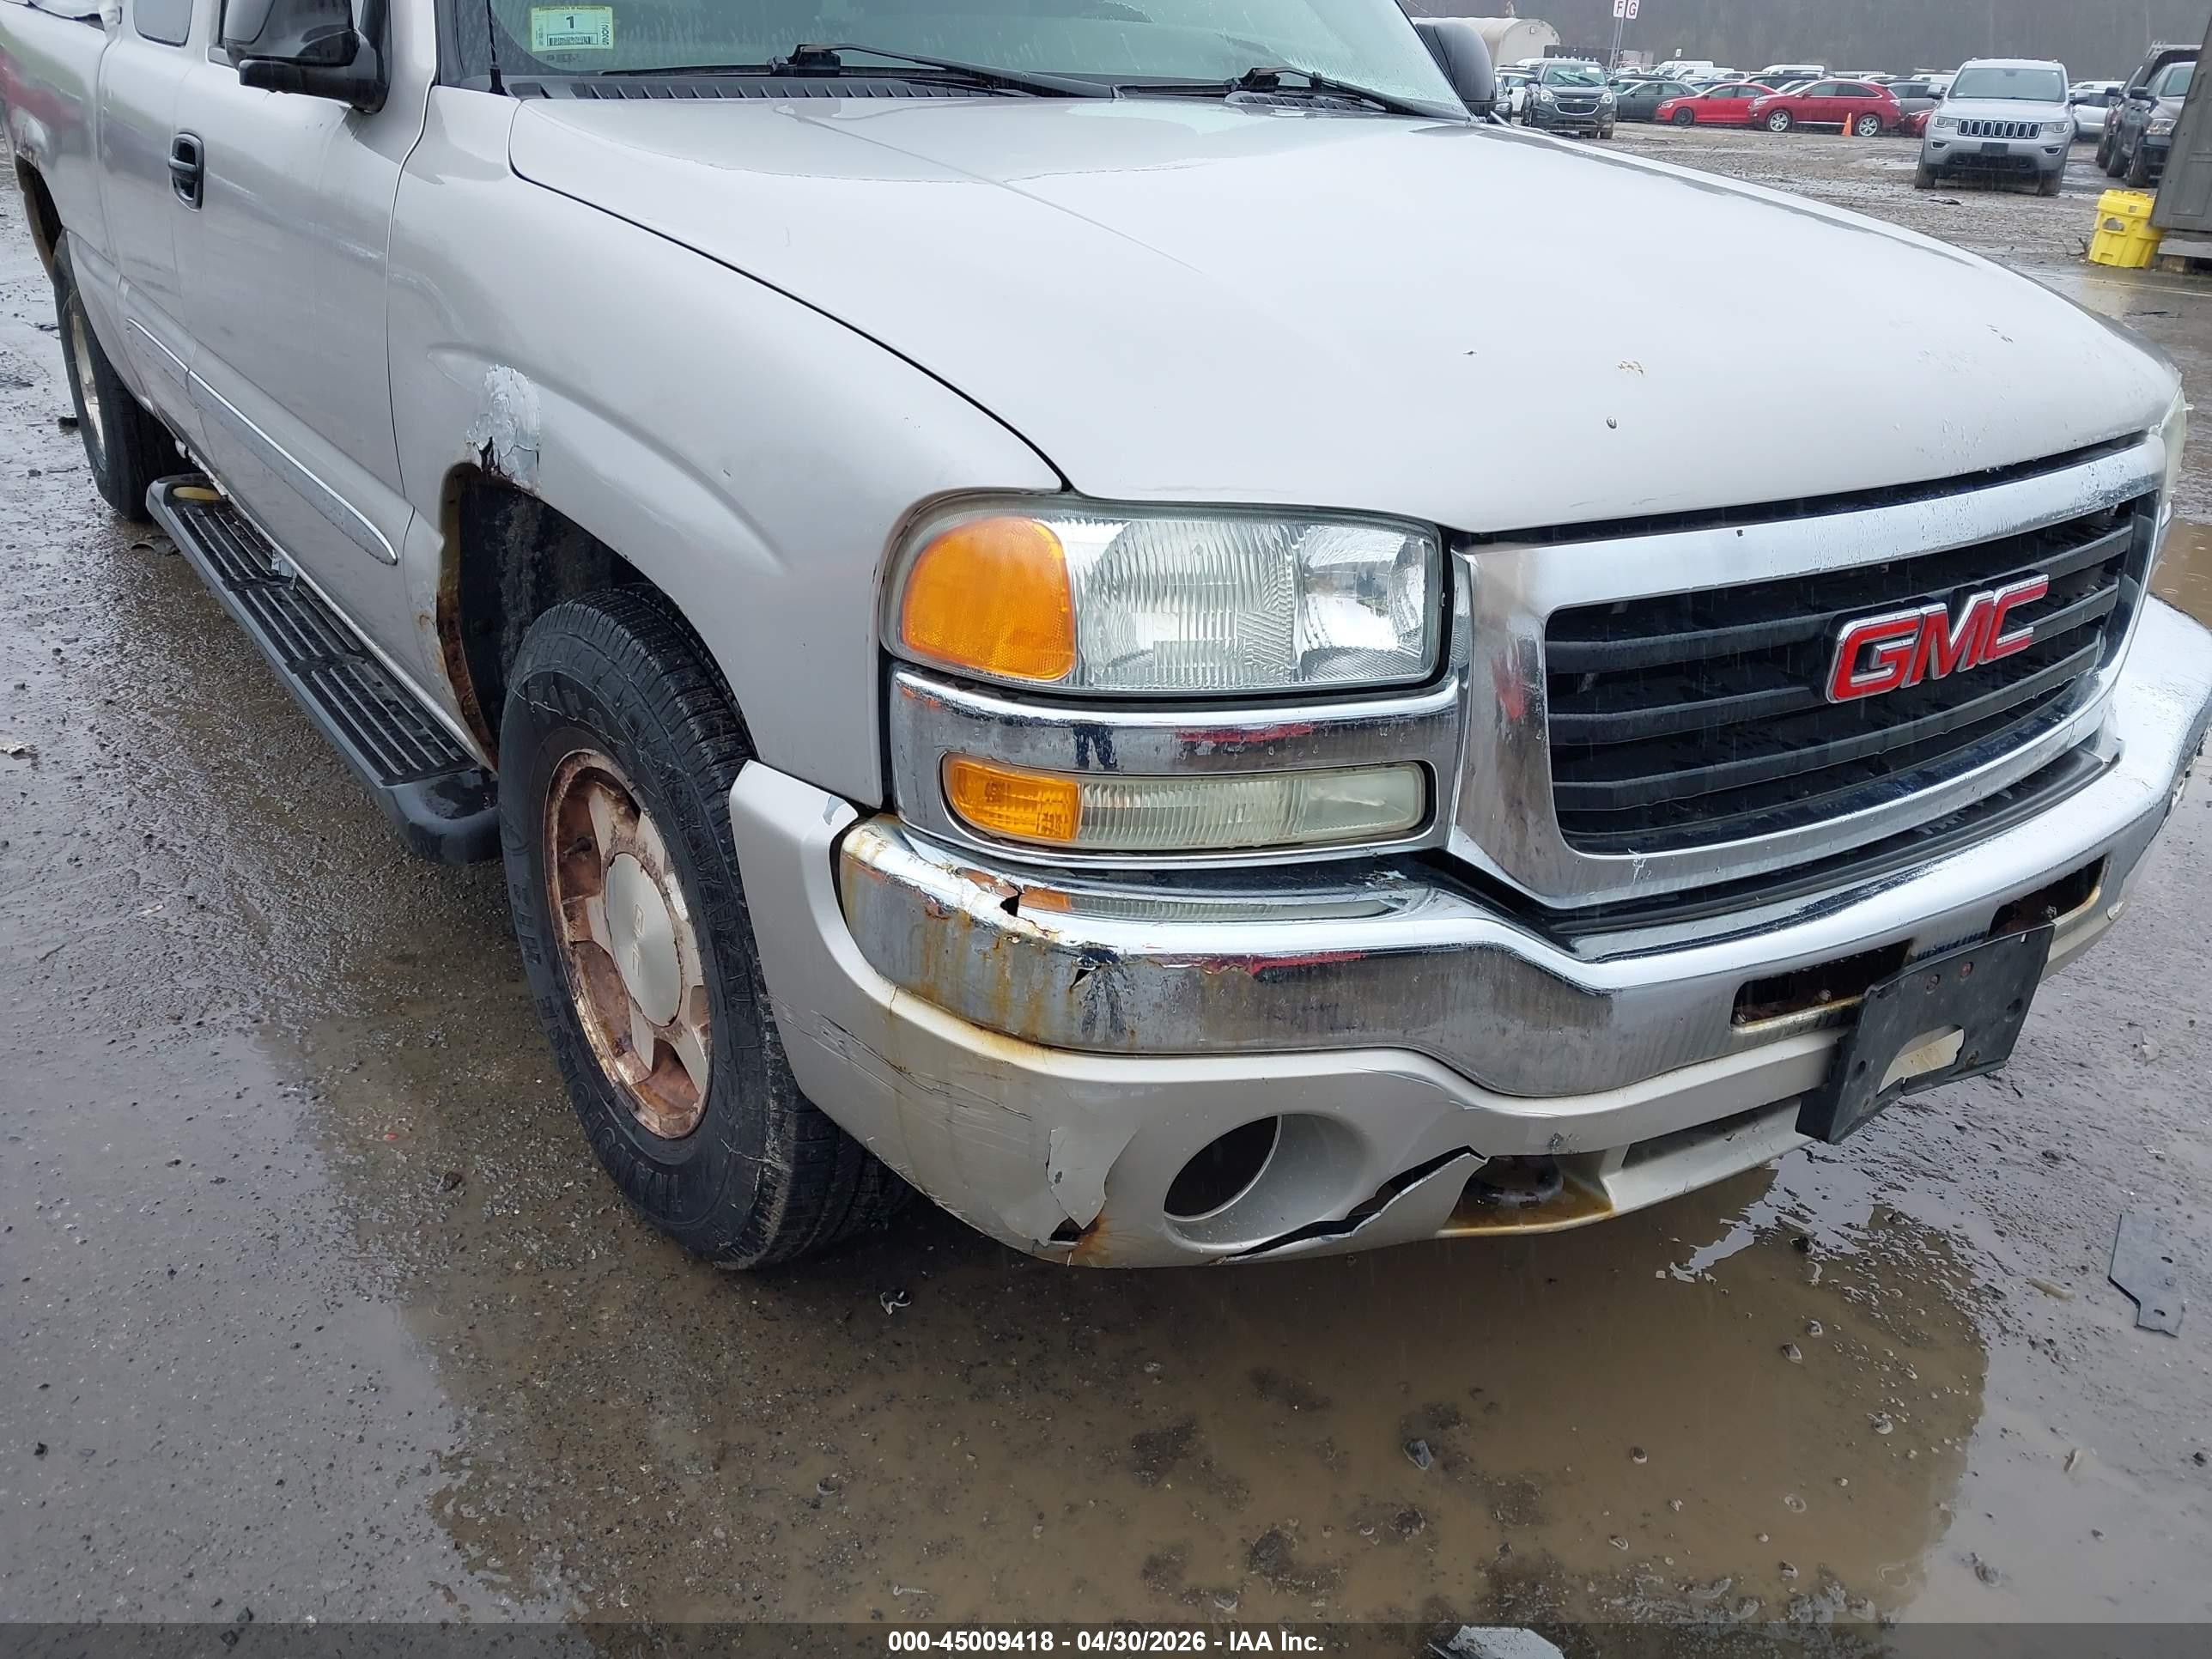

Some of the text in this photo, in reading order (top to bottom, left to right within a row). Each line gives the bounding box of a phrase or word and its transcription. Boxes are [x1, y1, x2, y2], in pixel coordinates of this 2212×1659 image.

[1616, 1, 1623, 14] F
[1629, 2, 1637, 15] G
[566, 15, 574, 28] 1
[1825, 573, 2050, 704] GMC
